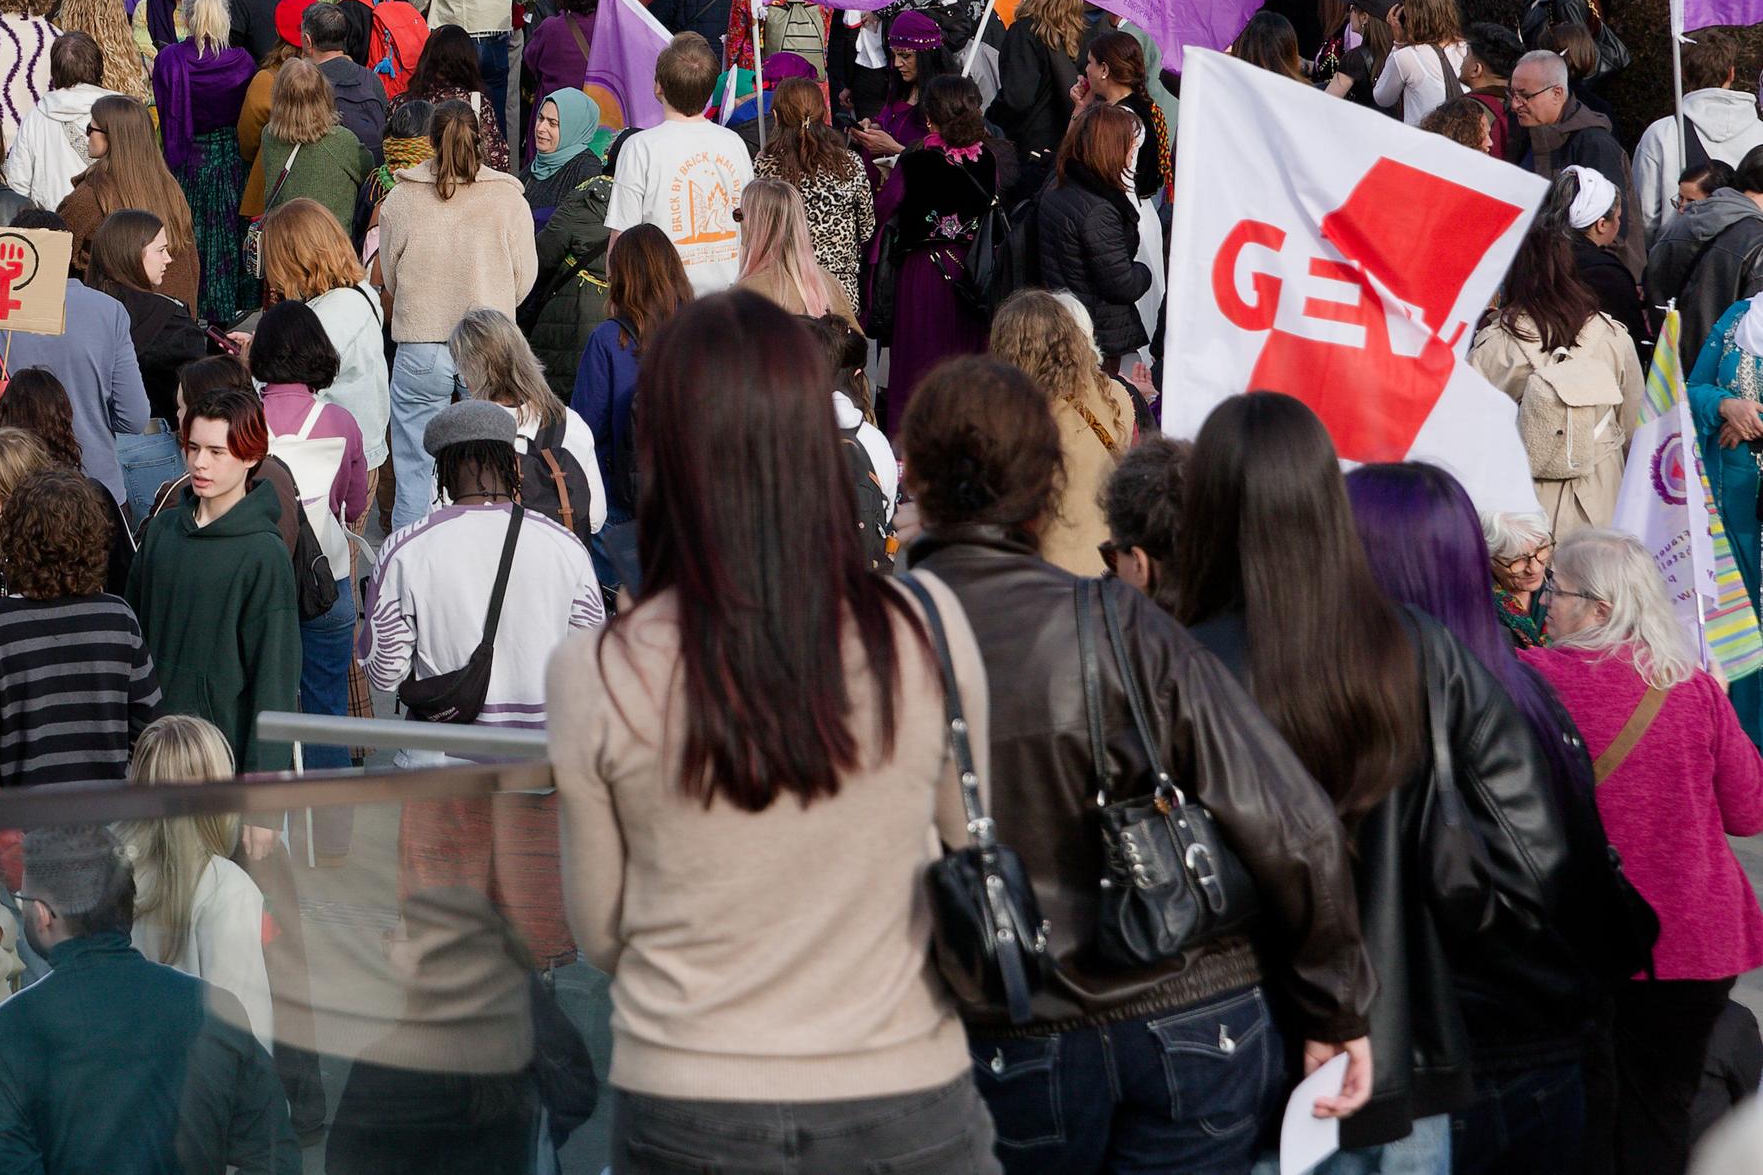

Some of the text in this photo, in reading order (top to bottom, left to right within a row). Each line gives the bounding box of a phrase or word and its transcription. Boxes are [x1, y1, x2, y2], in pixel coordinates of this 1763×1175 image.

[679, 151, 709, 176] BRICK
[716, 153, 736, 177] WALL
[672, 177, 683, 192] BY
[669, 196, 683, 232] BRICK
